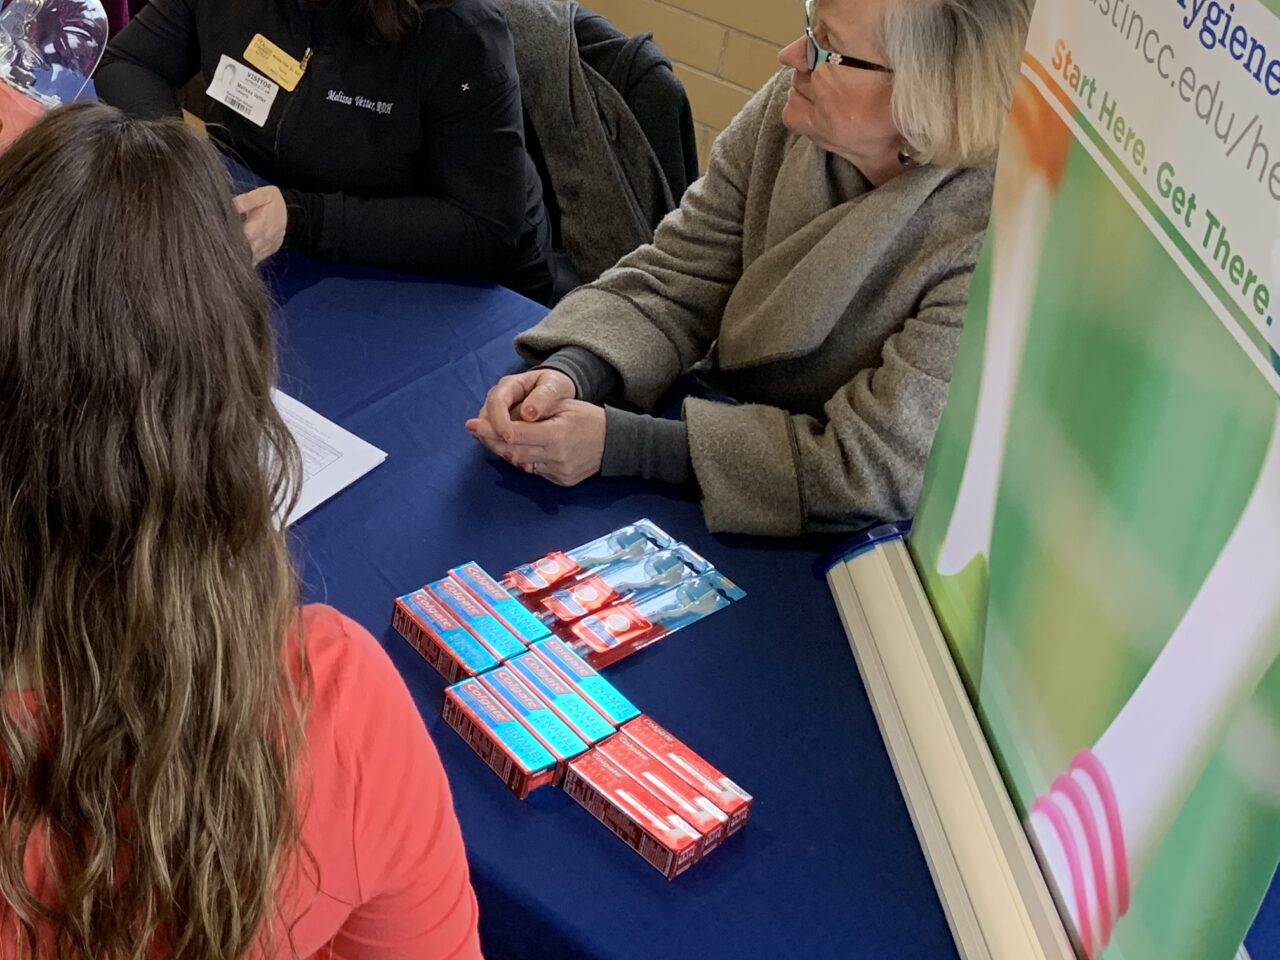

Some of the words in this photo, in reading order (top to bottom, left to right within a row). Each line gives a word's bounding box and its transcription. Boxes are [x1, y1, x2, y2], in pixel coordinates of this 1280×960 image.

[247, 71, 272, 89] VISITOR
[1052, 38, 1097, 109] Start
[1098, 91, 1148, 176] Here.
[1156, 161, 1197, 228] Get
[1202, 209, 1273, 327] There.
[444, 581, 480, 616] Colgate
[467, 566, 503, 599] Colgate
[416, 594, 452, 628] Colgate
[523, 655, 566, 692] Colgate
[549, 640, 591, 676] Colgate
[467, 681, 509, 721] Colgate
[497, 669, 539, 708] Colgate
[591, 681, 631, 714] ENAMEL
[539, 714, 577, 750] ENAMEL
[568, 698, 603, 732] ENAMEL
[643, 718, 673, 743] Colgate
[505, 726, 545, 763] ENAMEL
[619, 735, 649, 761] Colgate
[592, 752, 623, 778] Colgate
